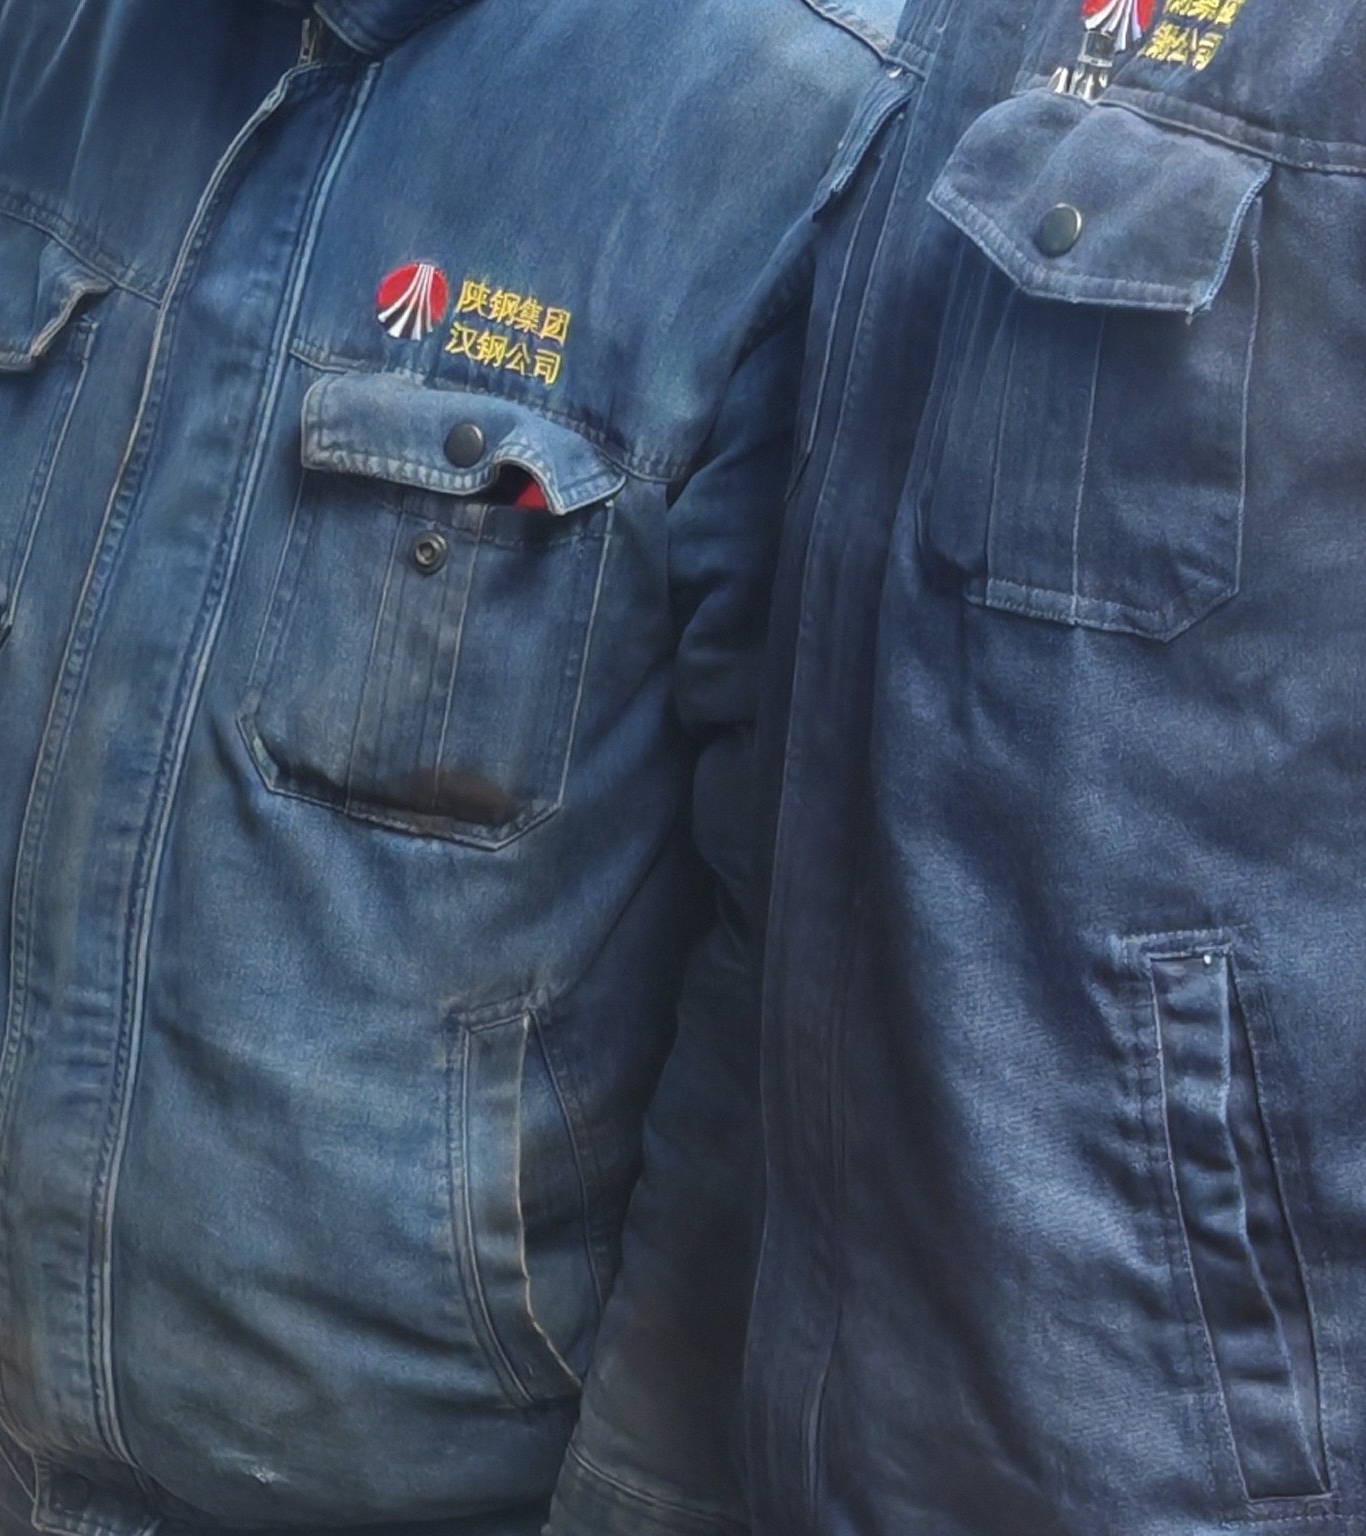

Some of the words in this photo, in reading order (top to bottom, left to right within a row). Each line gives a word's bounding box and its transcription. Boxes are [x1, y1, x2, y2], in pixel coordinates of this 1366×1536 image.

[455, 280, 571, 346] 陕钢集团
[445, 321, 561, 385] 汉钢公司
